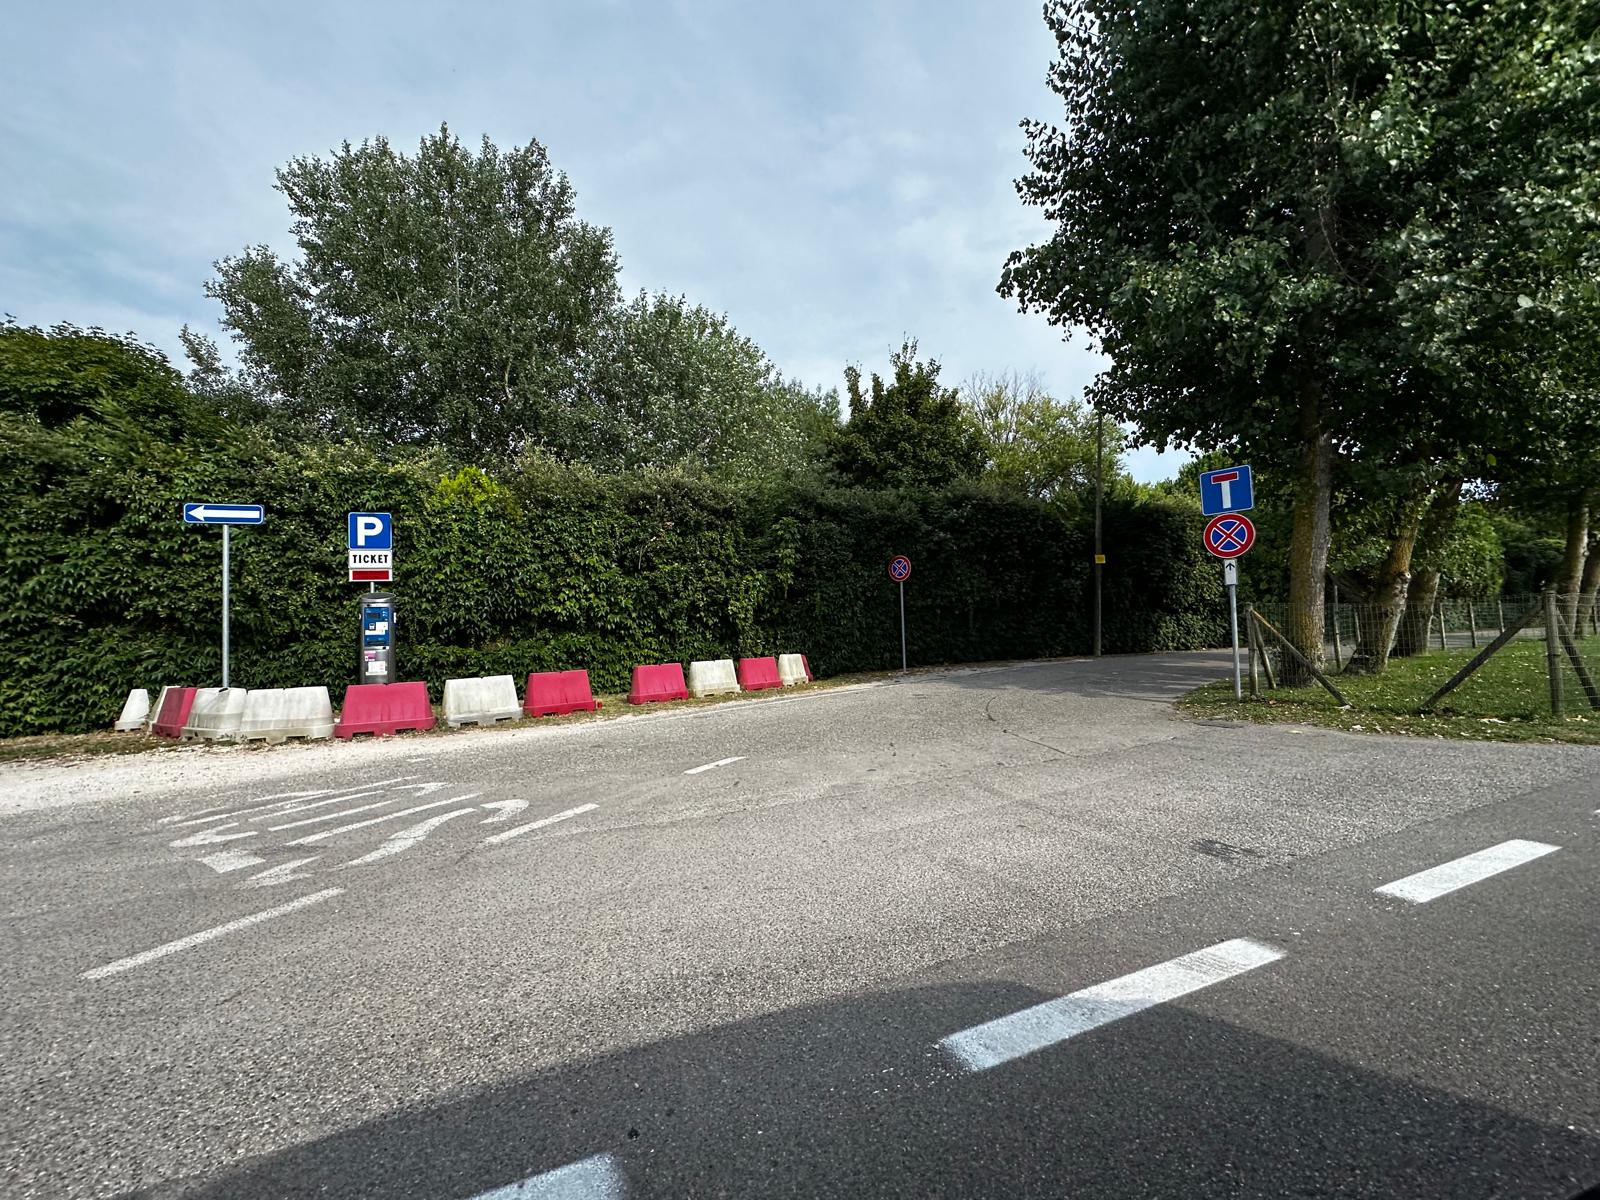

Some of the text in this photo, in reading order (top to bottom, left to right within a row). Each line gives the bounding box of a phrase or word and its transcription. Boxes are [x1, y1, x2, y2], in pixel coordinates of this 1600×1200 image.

[357, 516, 383, 546] P
[352, 554, 389, 564] TICKET
[157, 776, 529, 889] STOP
